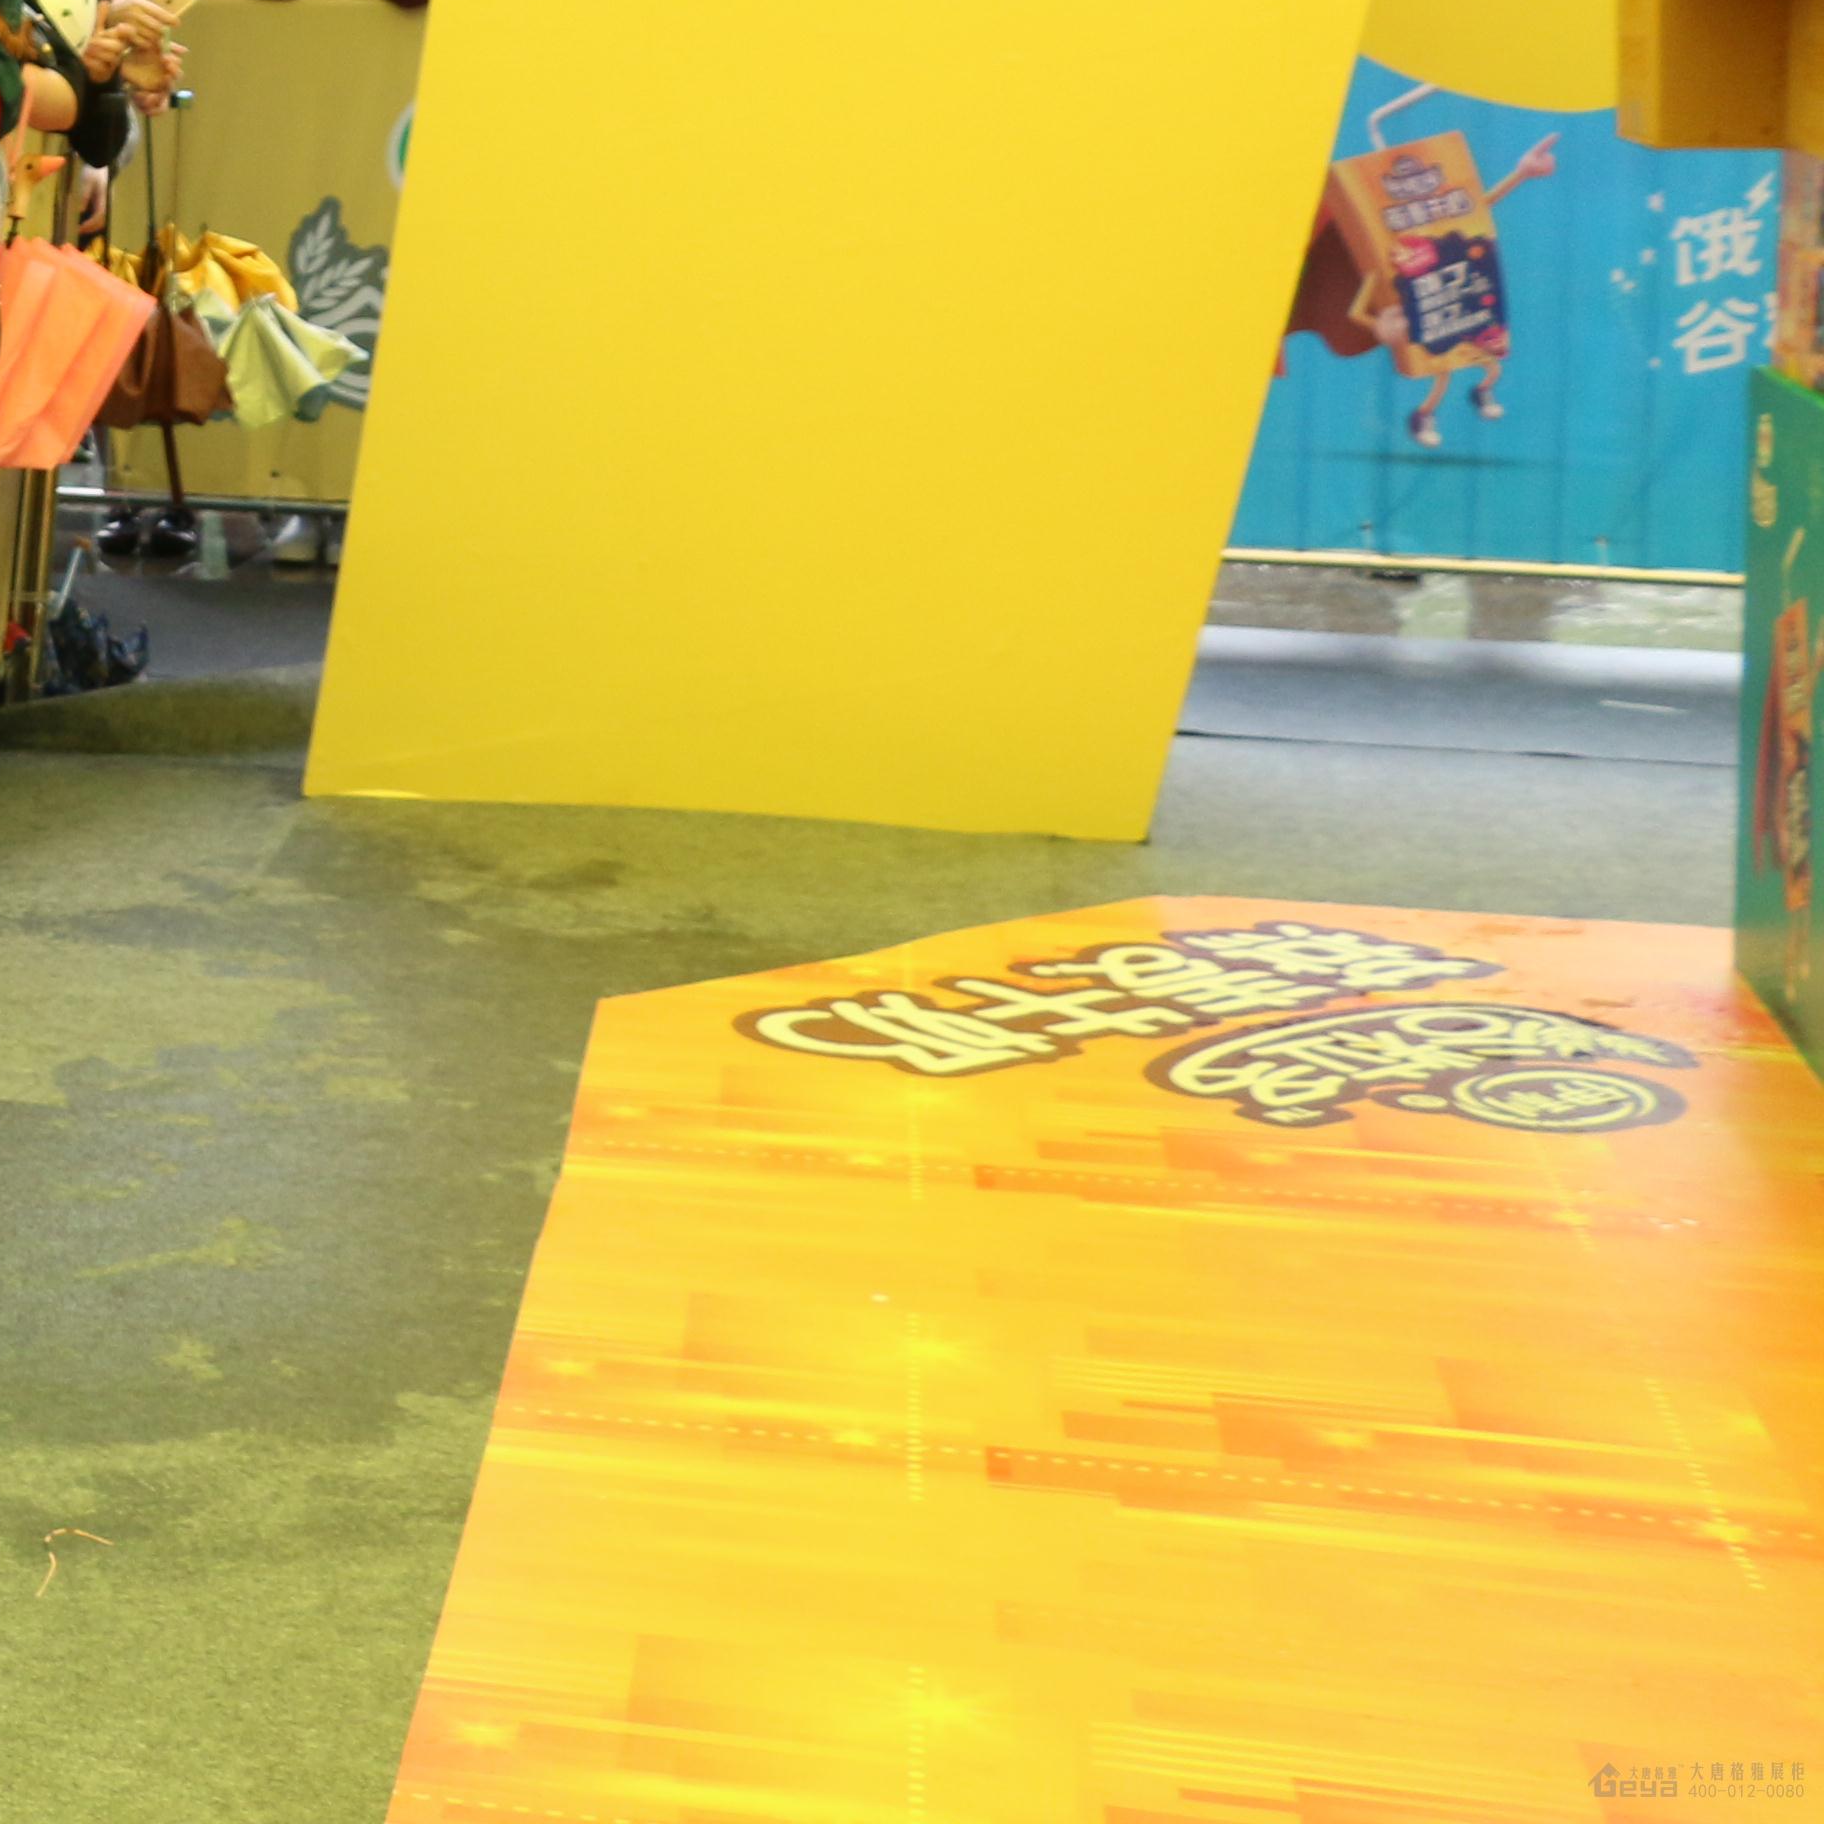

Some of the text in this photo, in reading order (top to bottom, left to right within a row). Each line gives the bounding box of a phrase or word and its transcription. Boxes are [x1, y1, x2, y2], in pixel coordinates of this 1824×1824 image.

[1672, 291, 1778, 374] 谷
[757, 924, 1480, 1074] 燕麦牛奶
